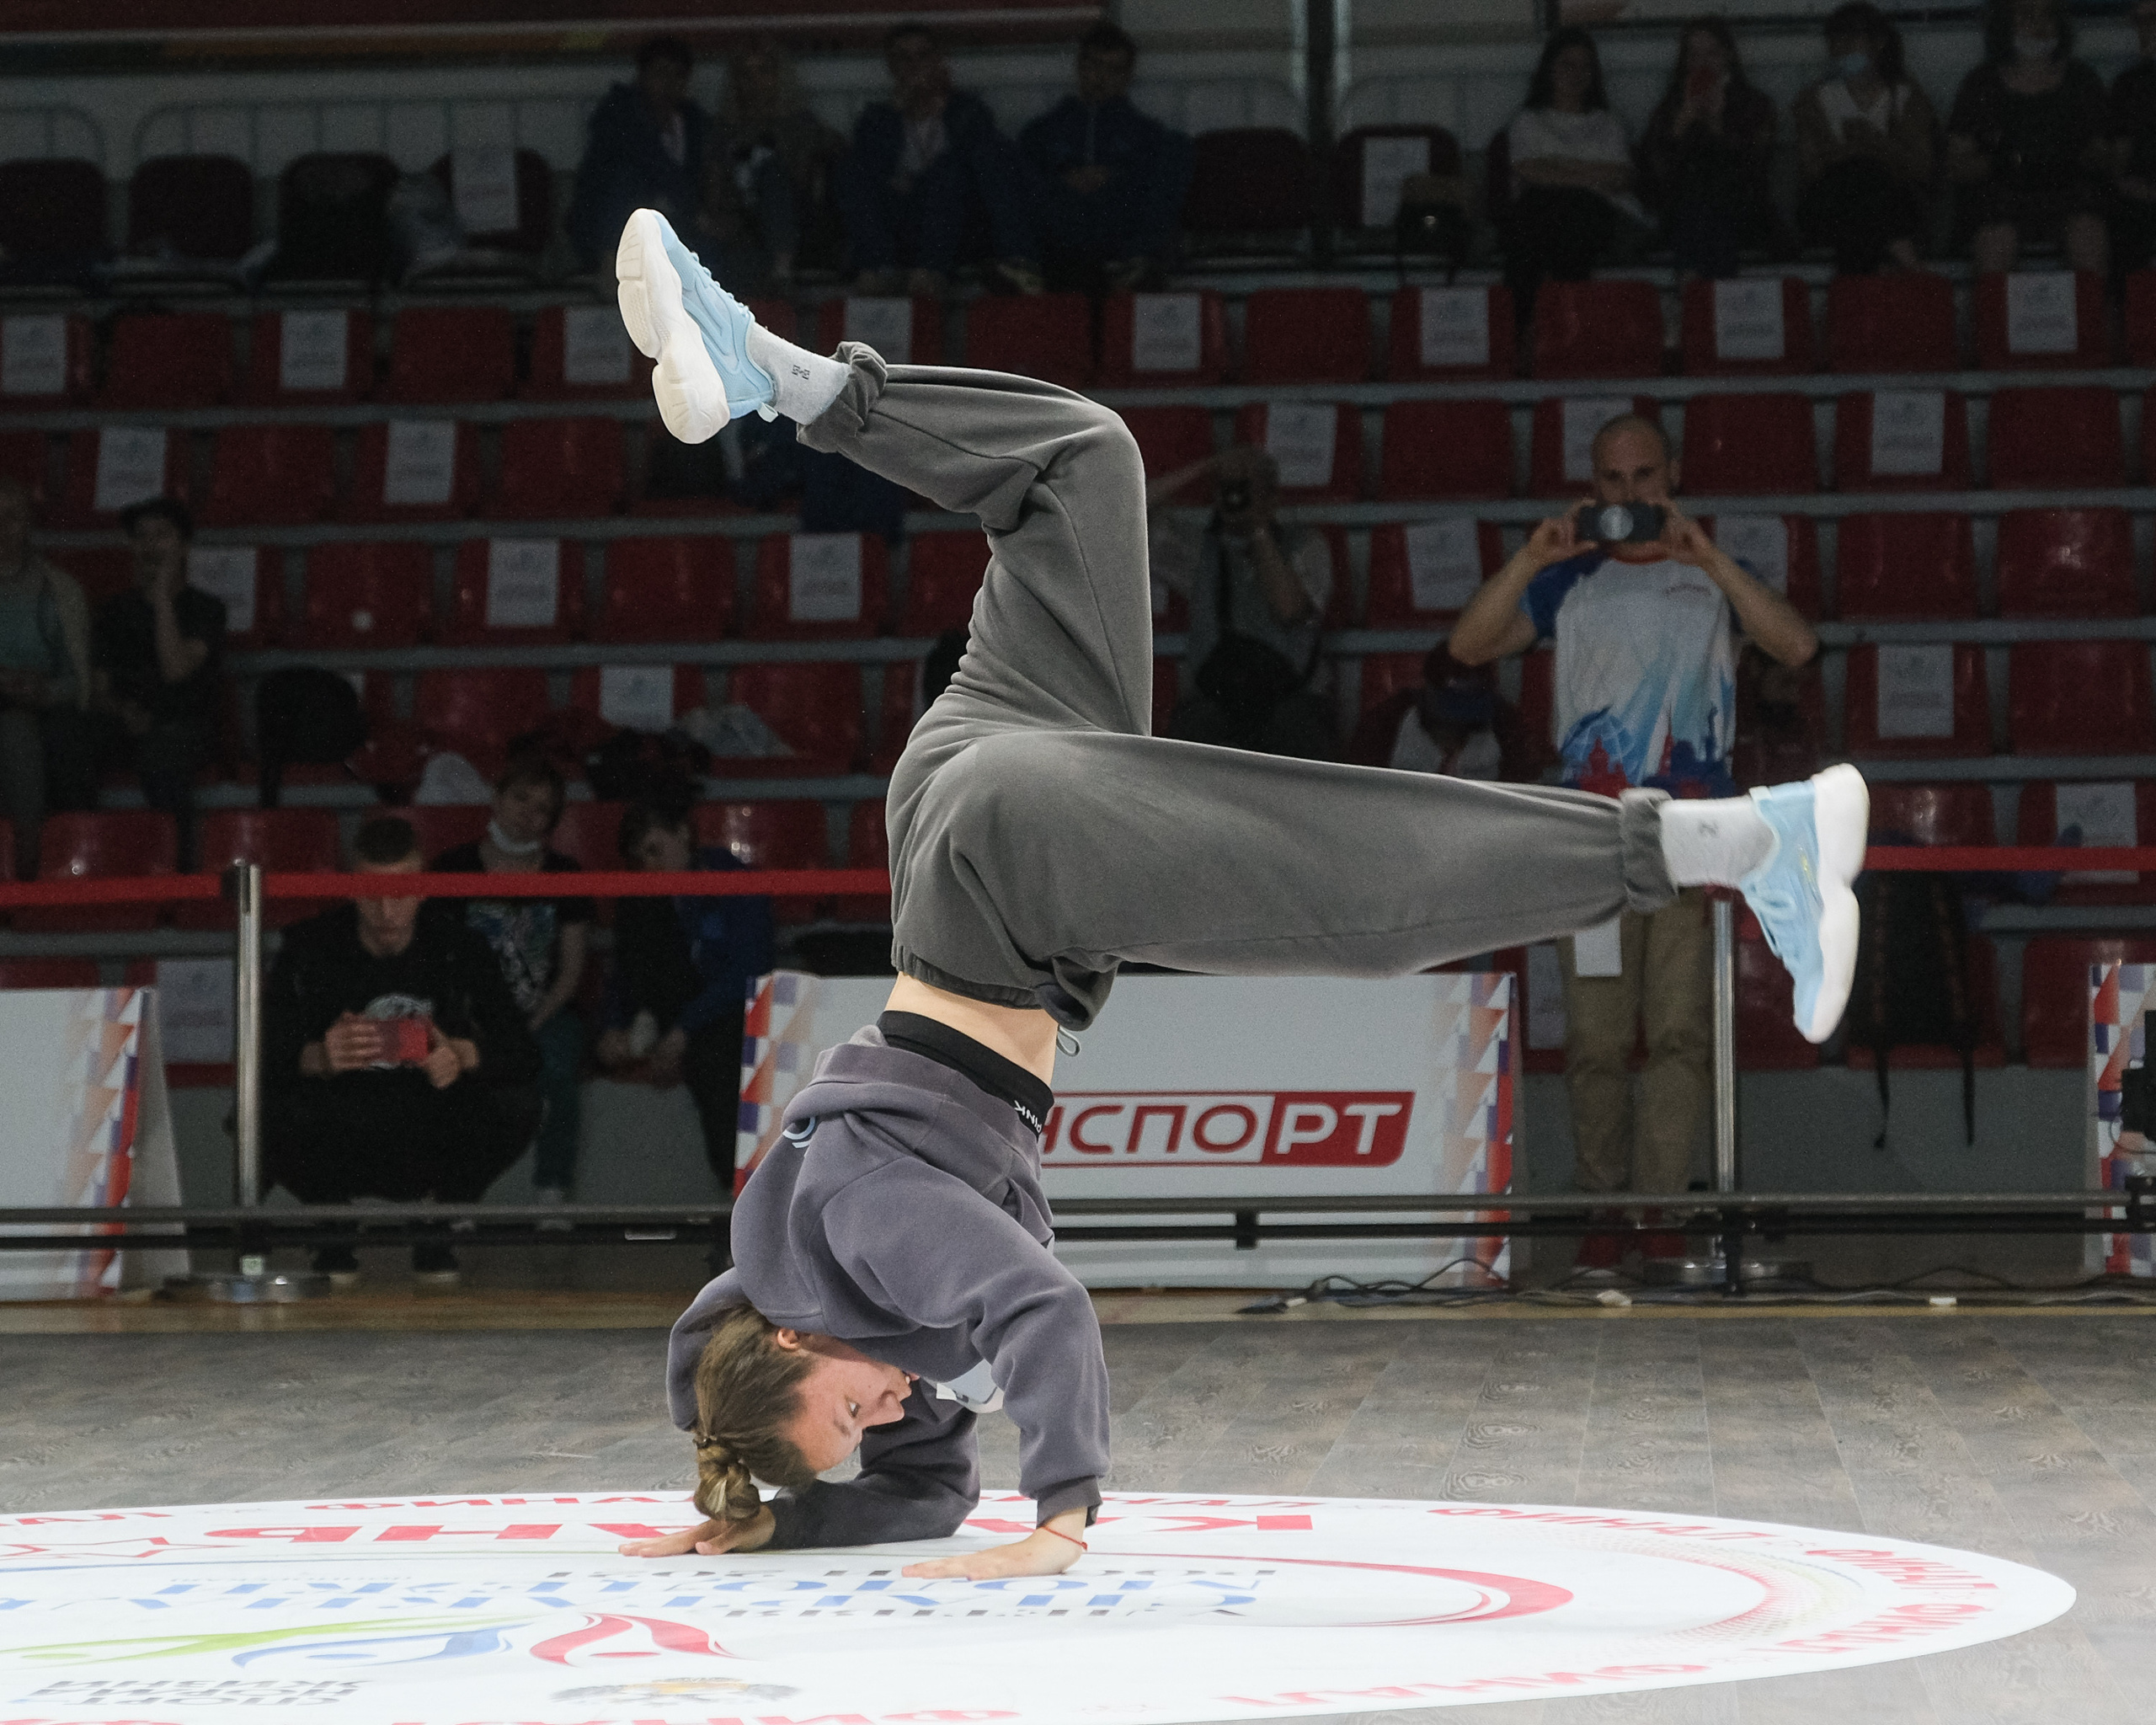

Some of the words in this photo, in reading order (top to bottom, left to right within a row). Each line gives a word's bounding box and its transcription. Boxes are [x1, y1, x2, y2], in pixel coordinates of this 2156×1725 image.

[304, 1497, 696, 1510] ФИНА
[204, 1514, 1315, 1543] КААНЬ
[1427, 1509, 1784, 1541] ФИНАЛ
[1805, 1549, 1999, 1589] ФИНАЛ
[1741, 1603, 1994, 1654] ФИНАЛ
[25, 1689, 358, 1697] НОРМА
[45, 1680, 371, 1689] ЖИЗНИ
[1209, 1664, 1711, 1707] ФИНАЛ
[62, 1697, 340, 1706] СПОРТ
